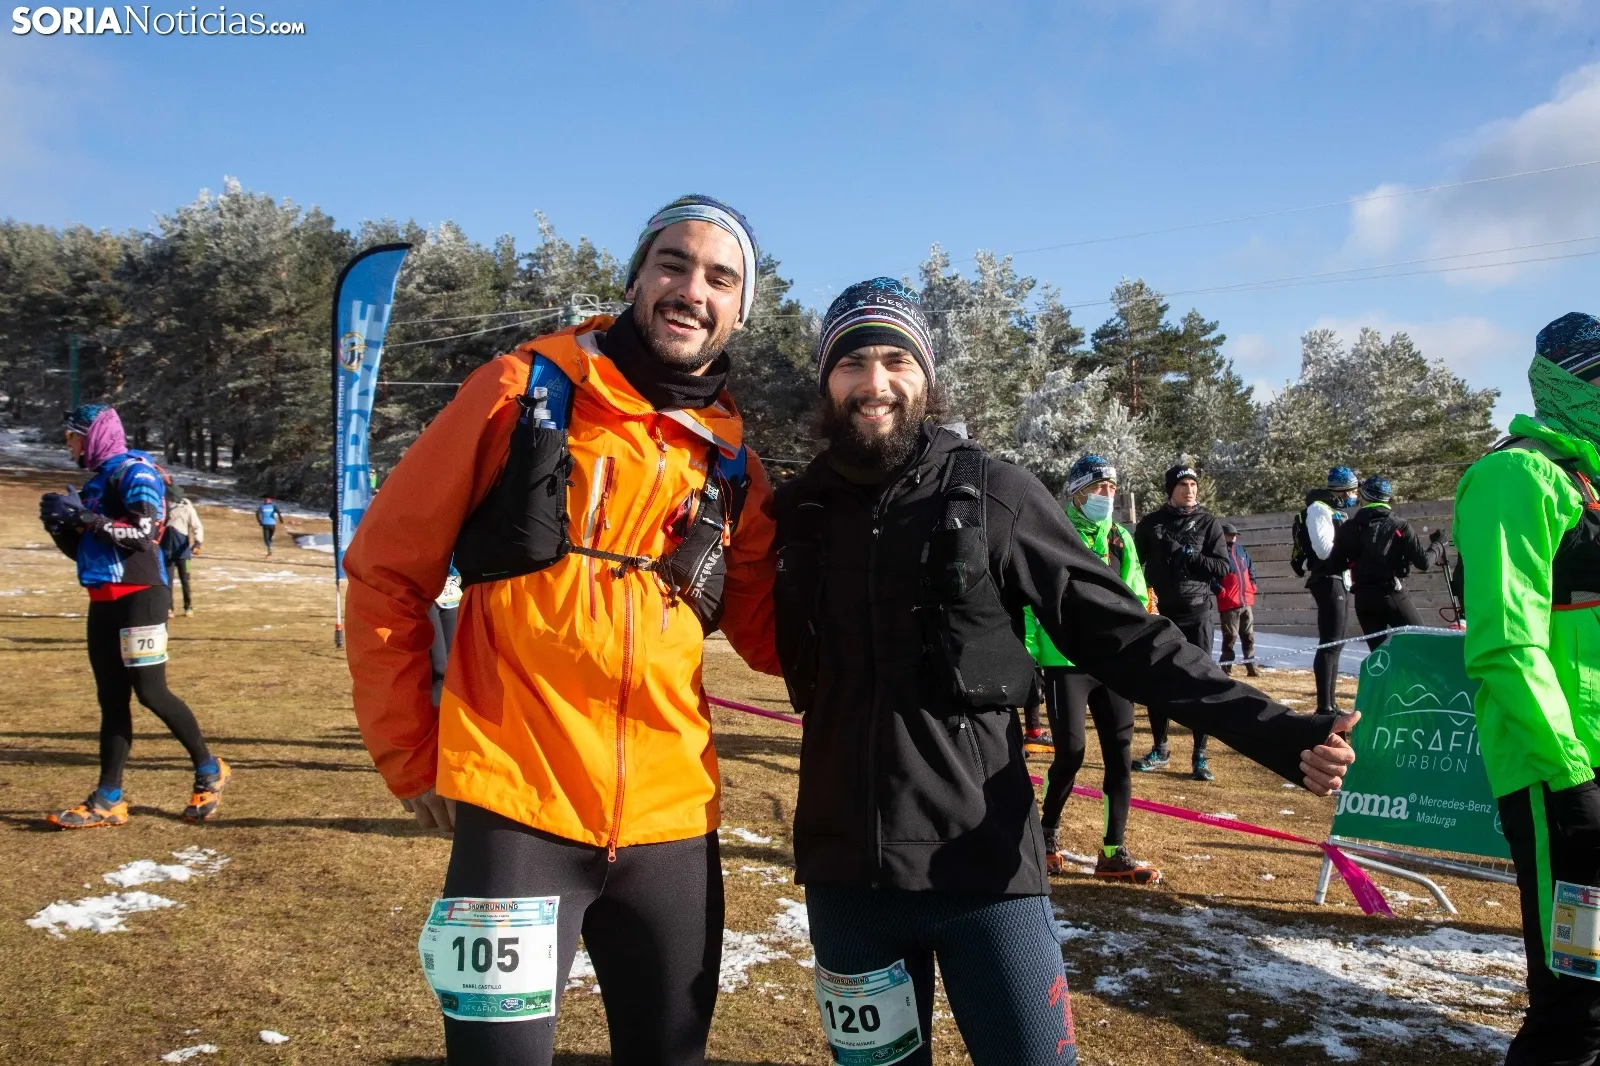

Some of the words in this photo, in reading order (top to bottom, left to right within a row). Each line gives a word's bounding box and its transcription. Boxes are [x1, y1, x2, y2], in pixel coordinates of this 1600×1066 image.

[137, 638, 155, 651] 70
[1395, 753, 1468, 773] URBIÓN
[1419, 794, 1492, 814] Mercedes-Benz
[1416, 811, 1457, 829] Madurga
[452, 936, 520, 973] 105
[825, 1000, 881, 1034] 120
